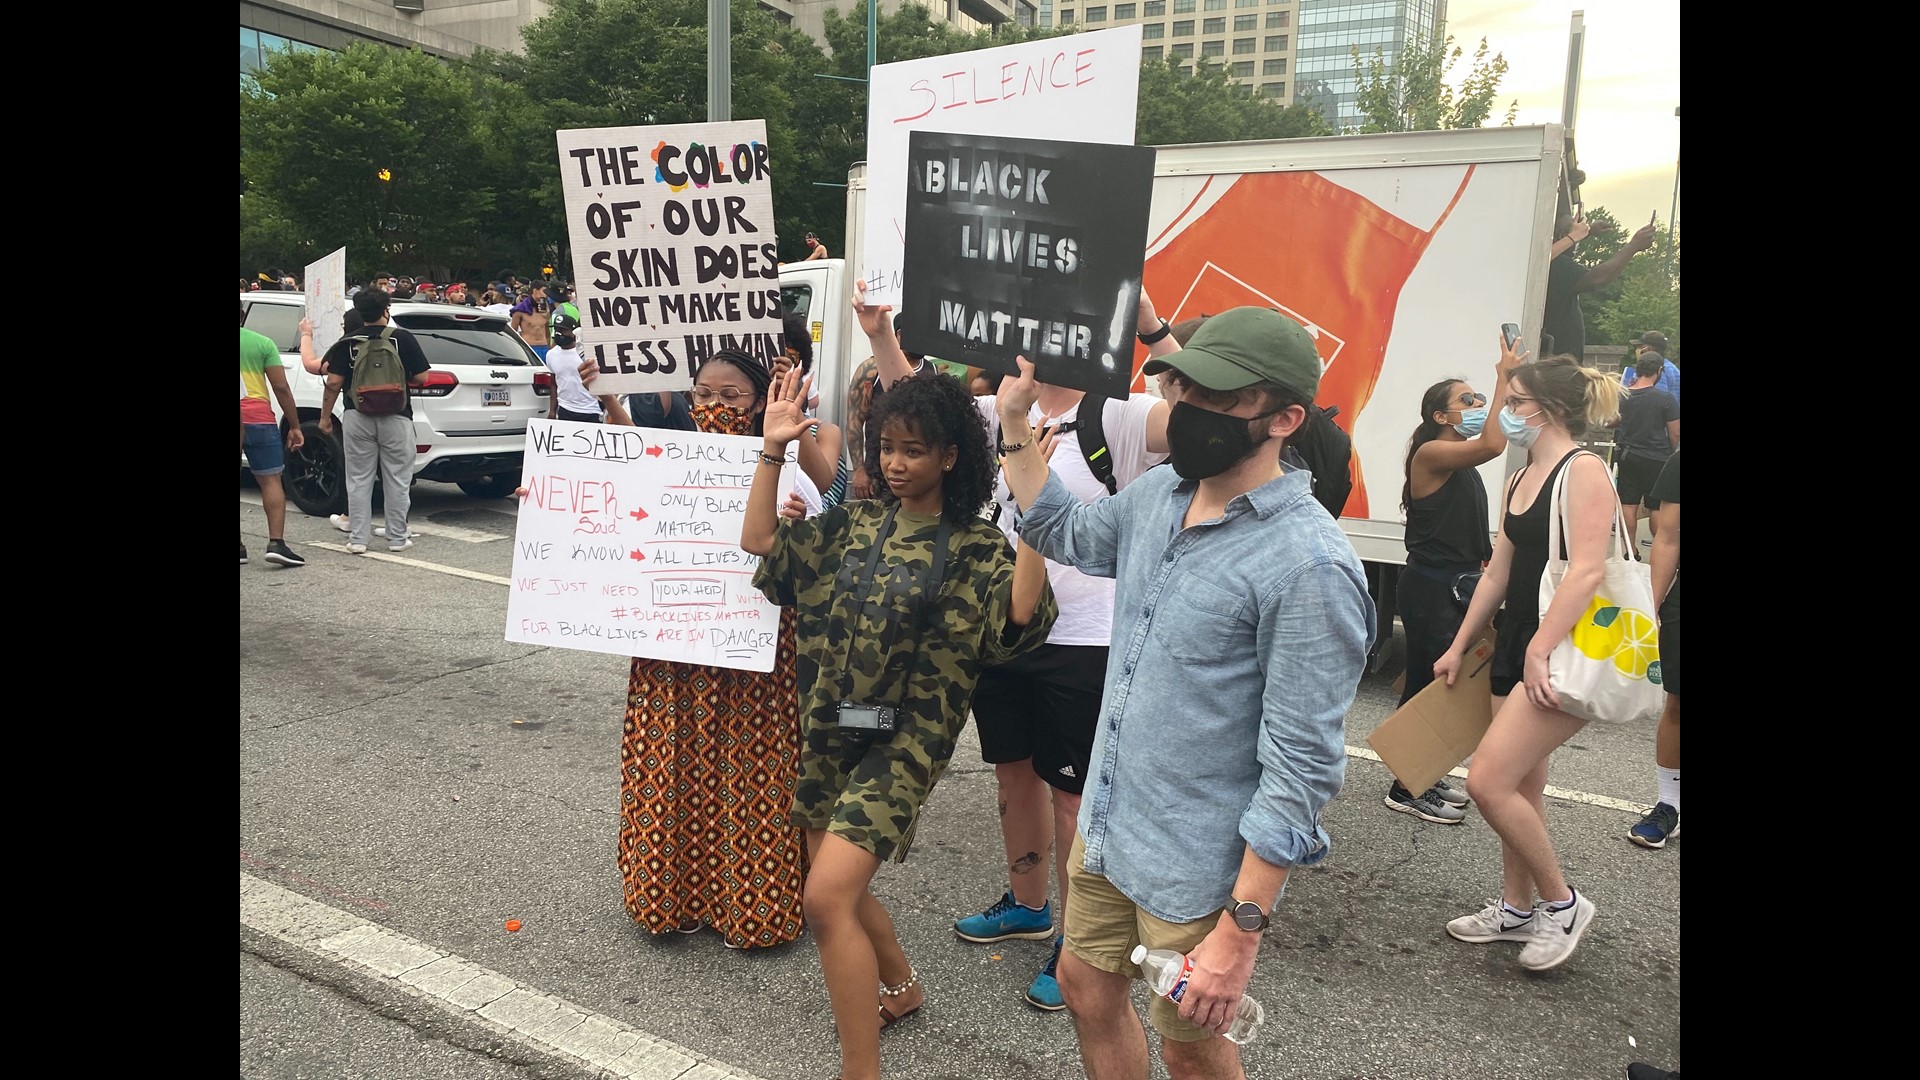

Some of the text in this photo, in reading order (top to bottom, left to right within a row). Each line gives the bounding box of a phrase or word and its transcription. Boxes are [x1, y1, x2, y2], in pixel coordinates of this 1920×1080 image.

[892, 48, 1097, 124] SILENCE
[569, 143, 770, 187] THE COLOR
[925, 157, 1051, 205] BLACK
[586, 196, 758, 240] OF OUR
[590, 243, 779, 291] SKIN DOES
[961, 225, 1078, 274] LIVES
[588, 289, 783, 328] NOT MAKE US
[490, 369, 509, 380] Jeep
[594, 340, 677, 375] LESS
[530, 425, 797, 465] WE SAID BLACK LIS
[523, 475, 747, 519] NEVER ONLY BLAC
[682, 469, 754, 489] MATTE
[573, 516, 621, 535] Said
[655, 521, 714, 538] MATTER
[521, 541, 553, 560] WE
[571, 544, 625, 561] KNOW
[653, 549, 682, 566] ALL
[691, 551, 740, 566] LIVES
[517, 578, 542, 592] WE
[546, 579, 588, 595] JUST
[602, 584, 639, 597] NEED
[656, 584, 690, 602] YOUR
[557, 621, 603, 637] BLACK
[607, 628, 649, 640] LIVES
[655, 628, 684, 642] ARE
[688, 629, 705, 642] IN
[710, 628, 775, 648] DANGER
